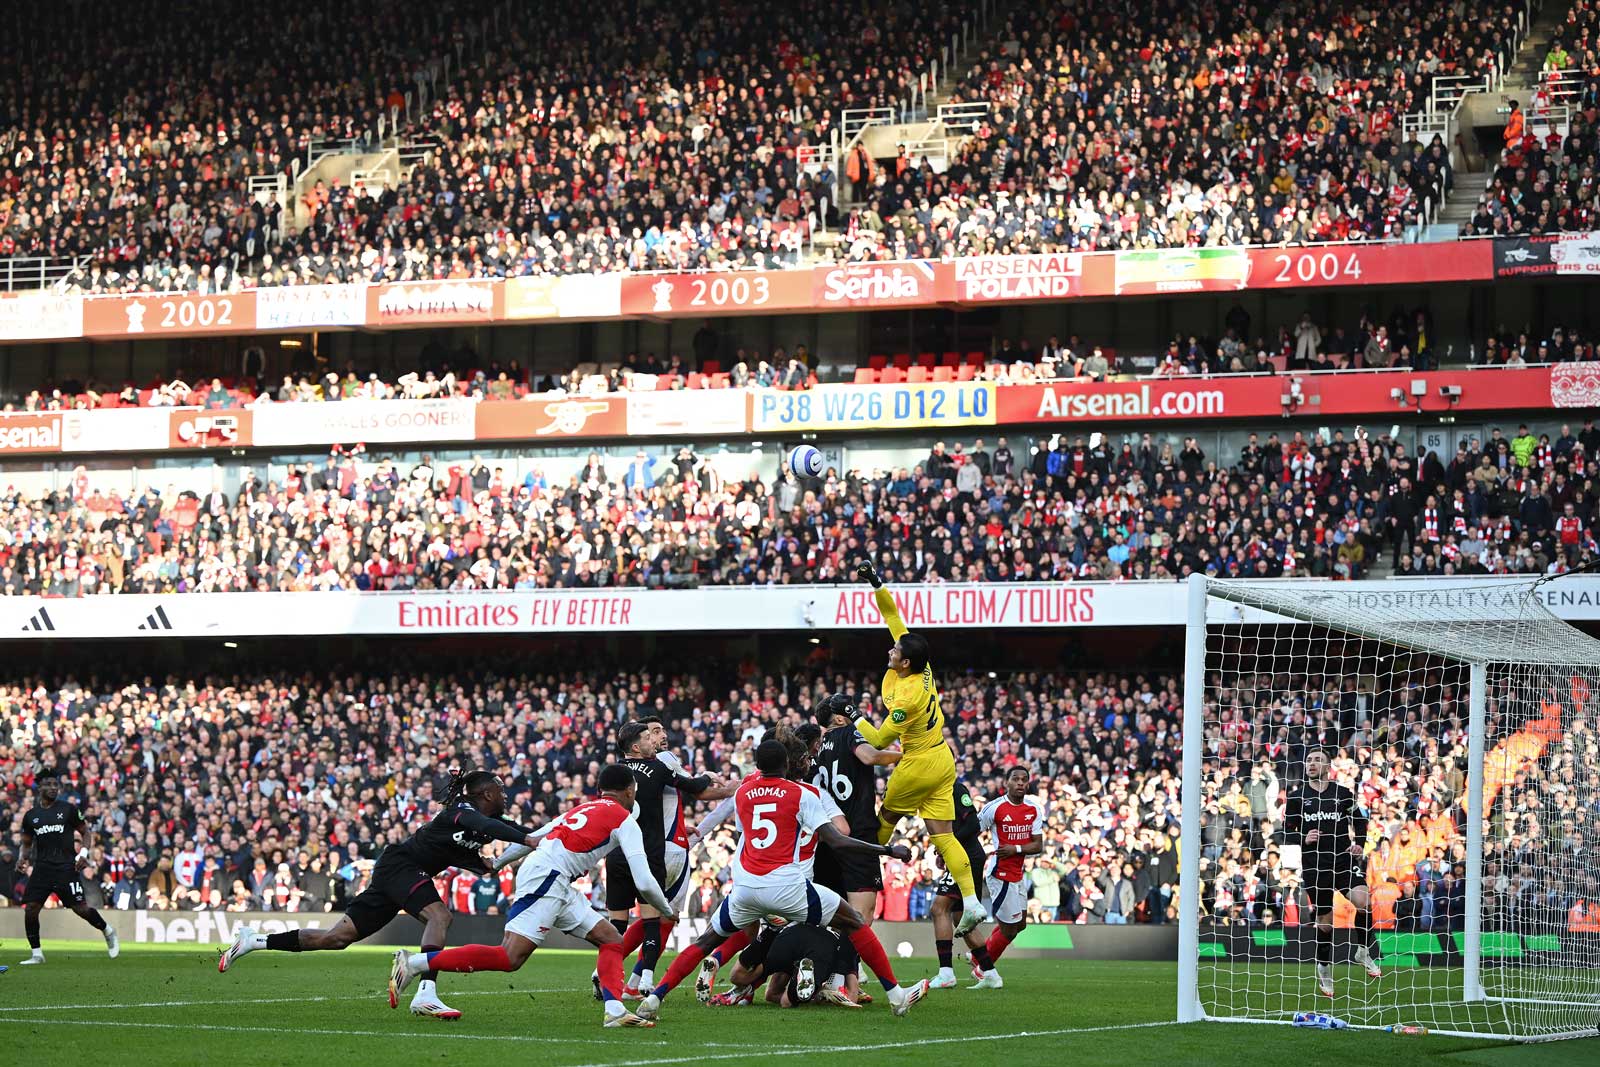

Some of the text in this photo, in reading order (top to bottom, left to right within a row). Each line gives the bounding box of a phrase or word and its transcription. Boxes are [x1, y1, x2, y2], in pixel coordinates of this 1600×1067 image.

[963, 257, 1075, 277] ARSENAL
[1275, 253, 1361, 282] 2004
[1498, 263, 1581, 276] SUPPORTERS
[691, 278, 769, 305] 2003
[825, 268, 918, 300] Serbia
[966, 277, 1070, 299] POLAND
[161, 299, 232, 327] 2002
[762, 394, 811, 423] P38
[823, 392, 882, 421] W26
[894, 388, 945, 419] D12
[1037, 385, 1224, 417] Arsenal.com
[1428, 434, 1440, 446] 65
[826, 450, 837, 461] 64
[399, 599, 632, 627] Emirates FLY BETTER
[835, 588, 1094, 625] ARSNAL.COM/TOURS
[745, 787, 786, 800] THOMAS
[750, 803, 777, 849] 5
[1304, 810, 1342, 822] betway
[34, 823, 64, 836] betway
[69, 882, 83, 895] 14
[939, 872, 955, 886] 25
